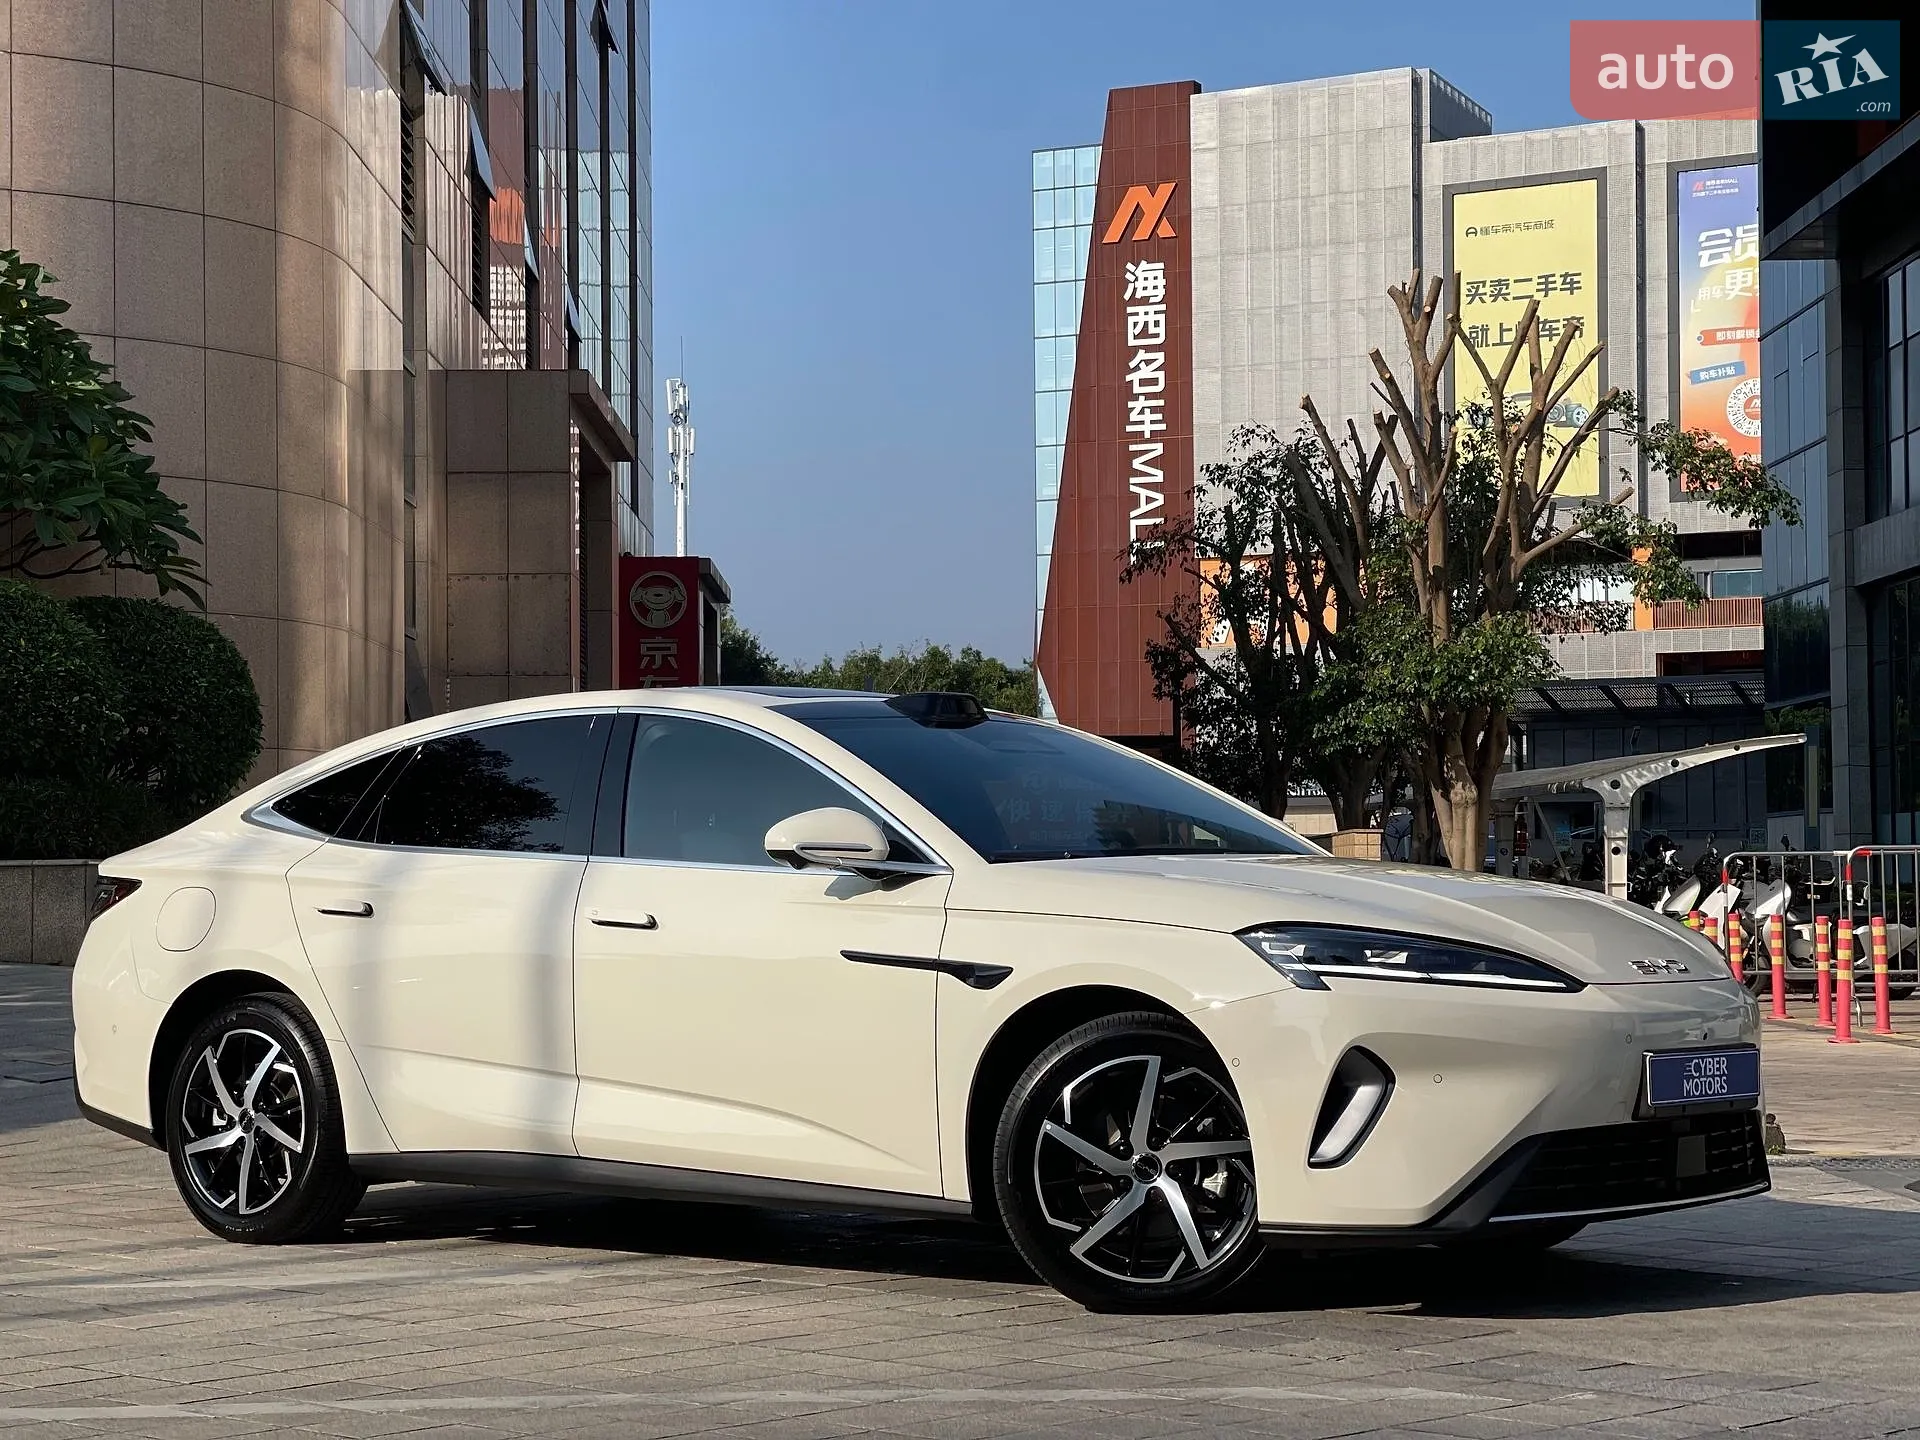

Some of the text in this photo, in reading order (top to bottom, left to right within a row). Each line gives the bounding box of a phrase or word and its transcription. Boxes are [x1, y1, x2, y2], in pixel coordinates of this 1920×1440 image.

[1465, 271, 1583, 305] 买卖二手车
[1691, 1057, 1729, 1077] CYBER
[1683, 1076, 1728, 1097] MOTORS
